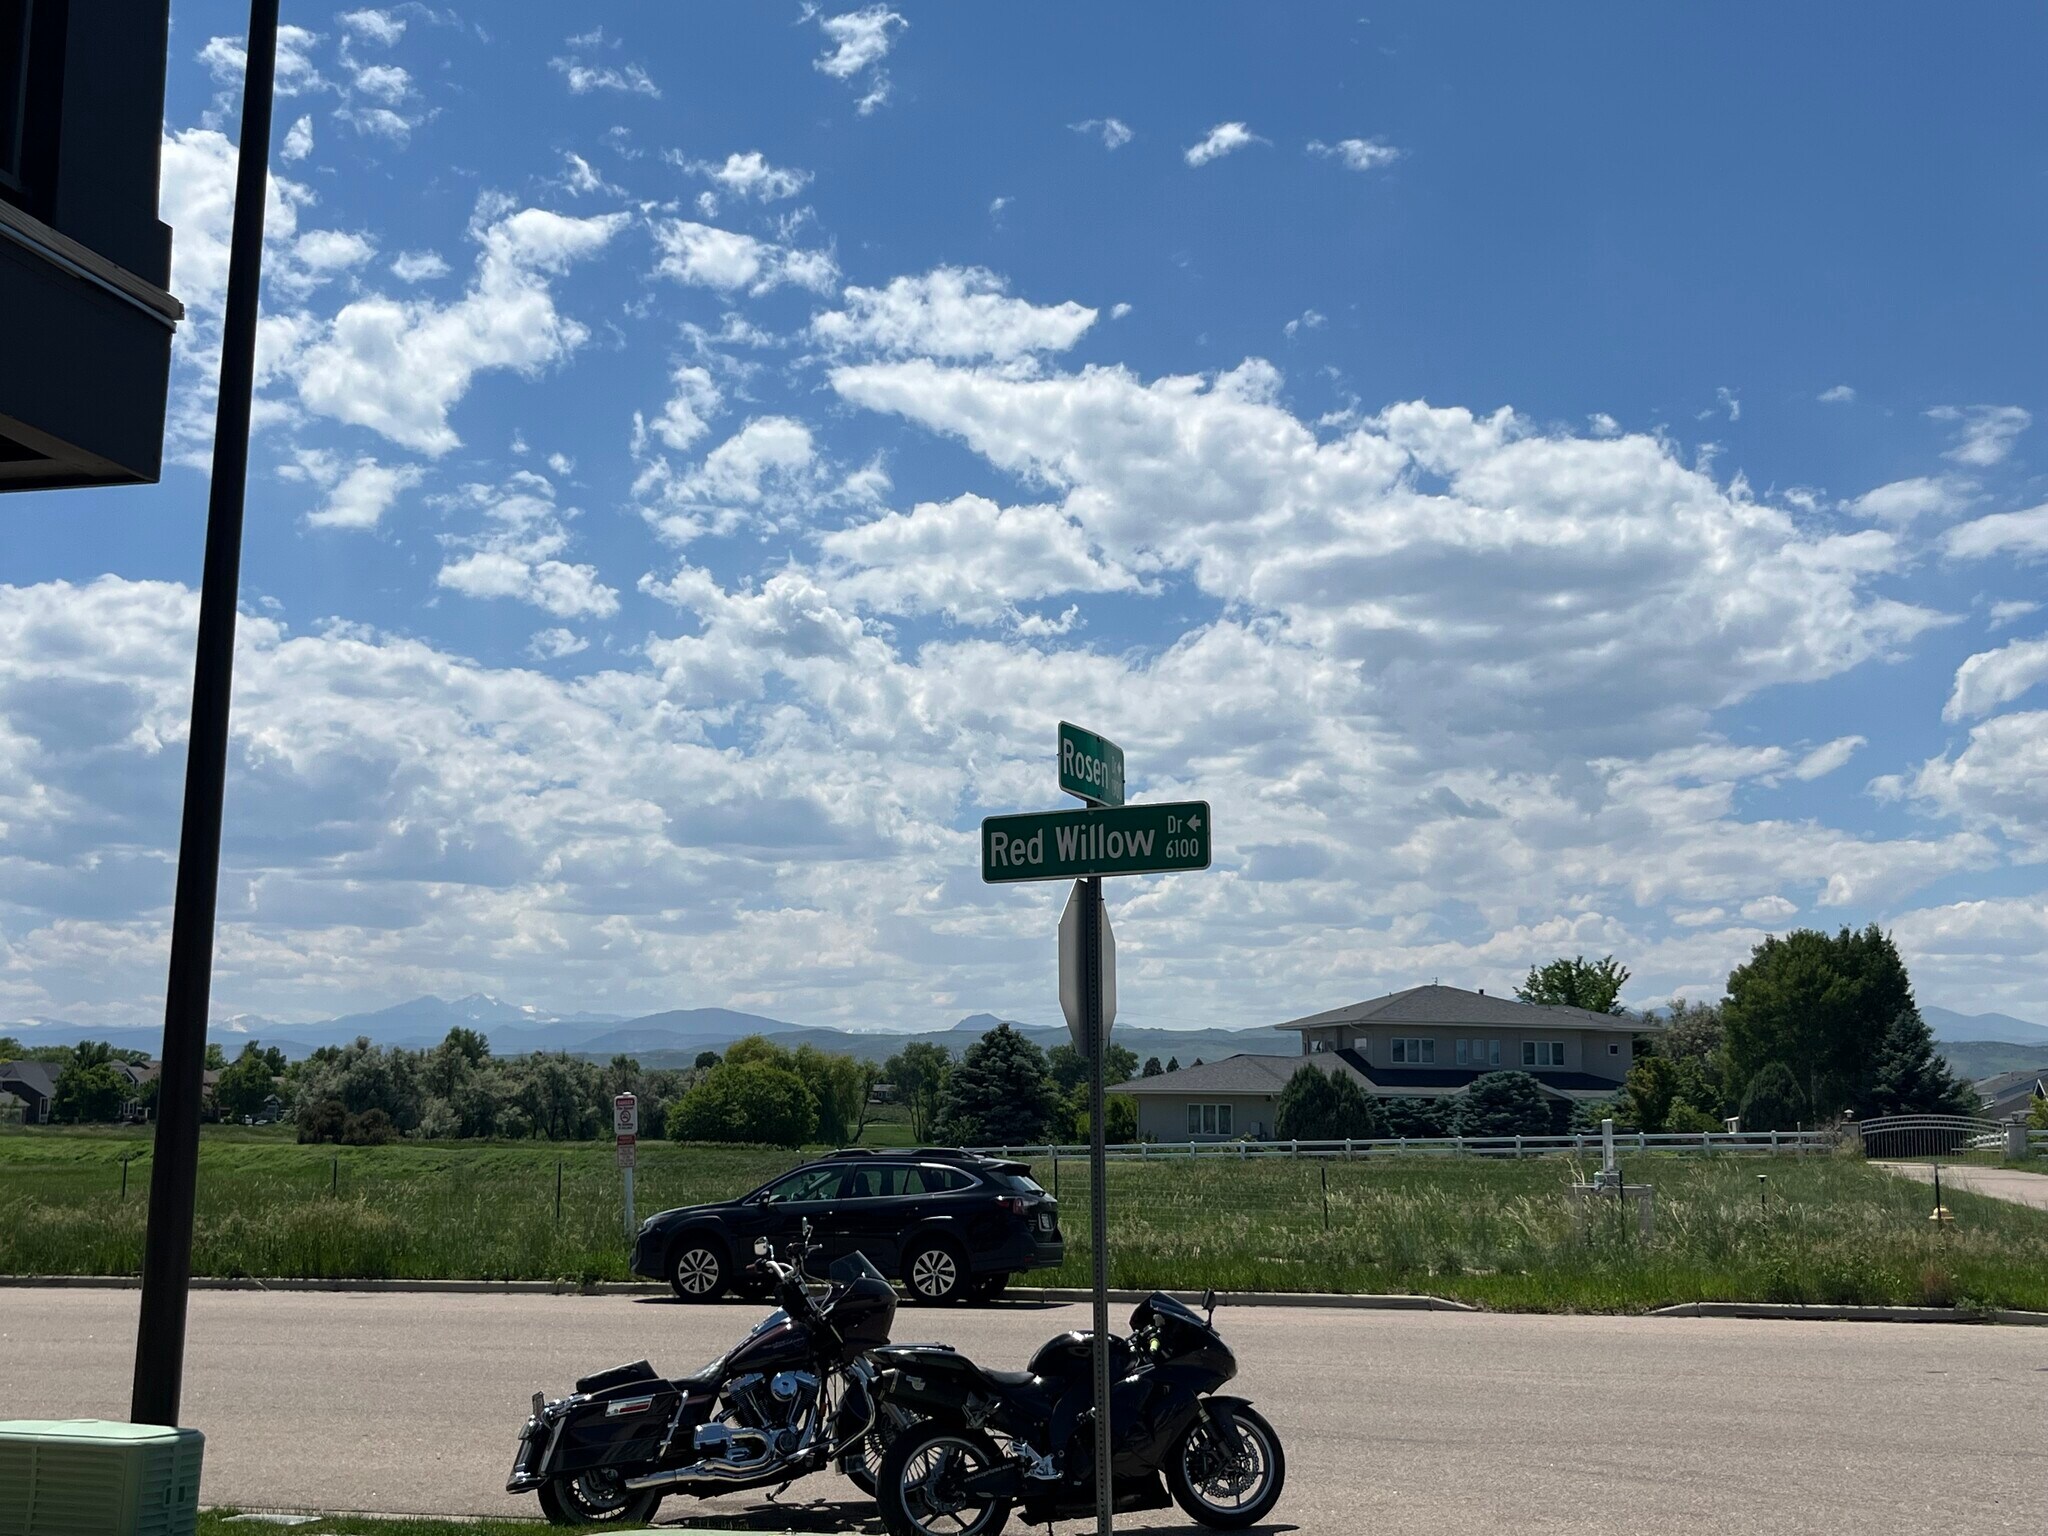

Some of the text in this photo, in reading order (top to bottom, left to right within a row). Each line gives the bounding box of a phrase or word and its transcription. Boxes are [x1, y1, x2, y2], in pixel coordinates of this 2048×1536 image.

[1063, 738, 1109, 790] Rosen
[1167, 815, 1183, 834] Dr
[991, 824, 1155, 867] Red Willow
[1166, 838, 1199, 858] 6100
